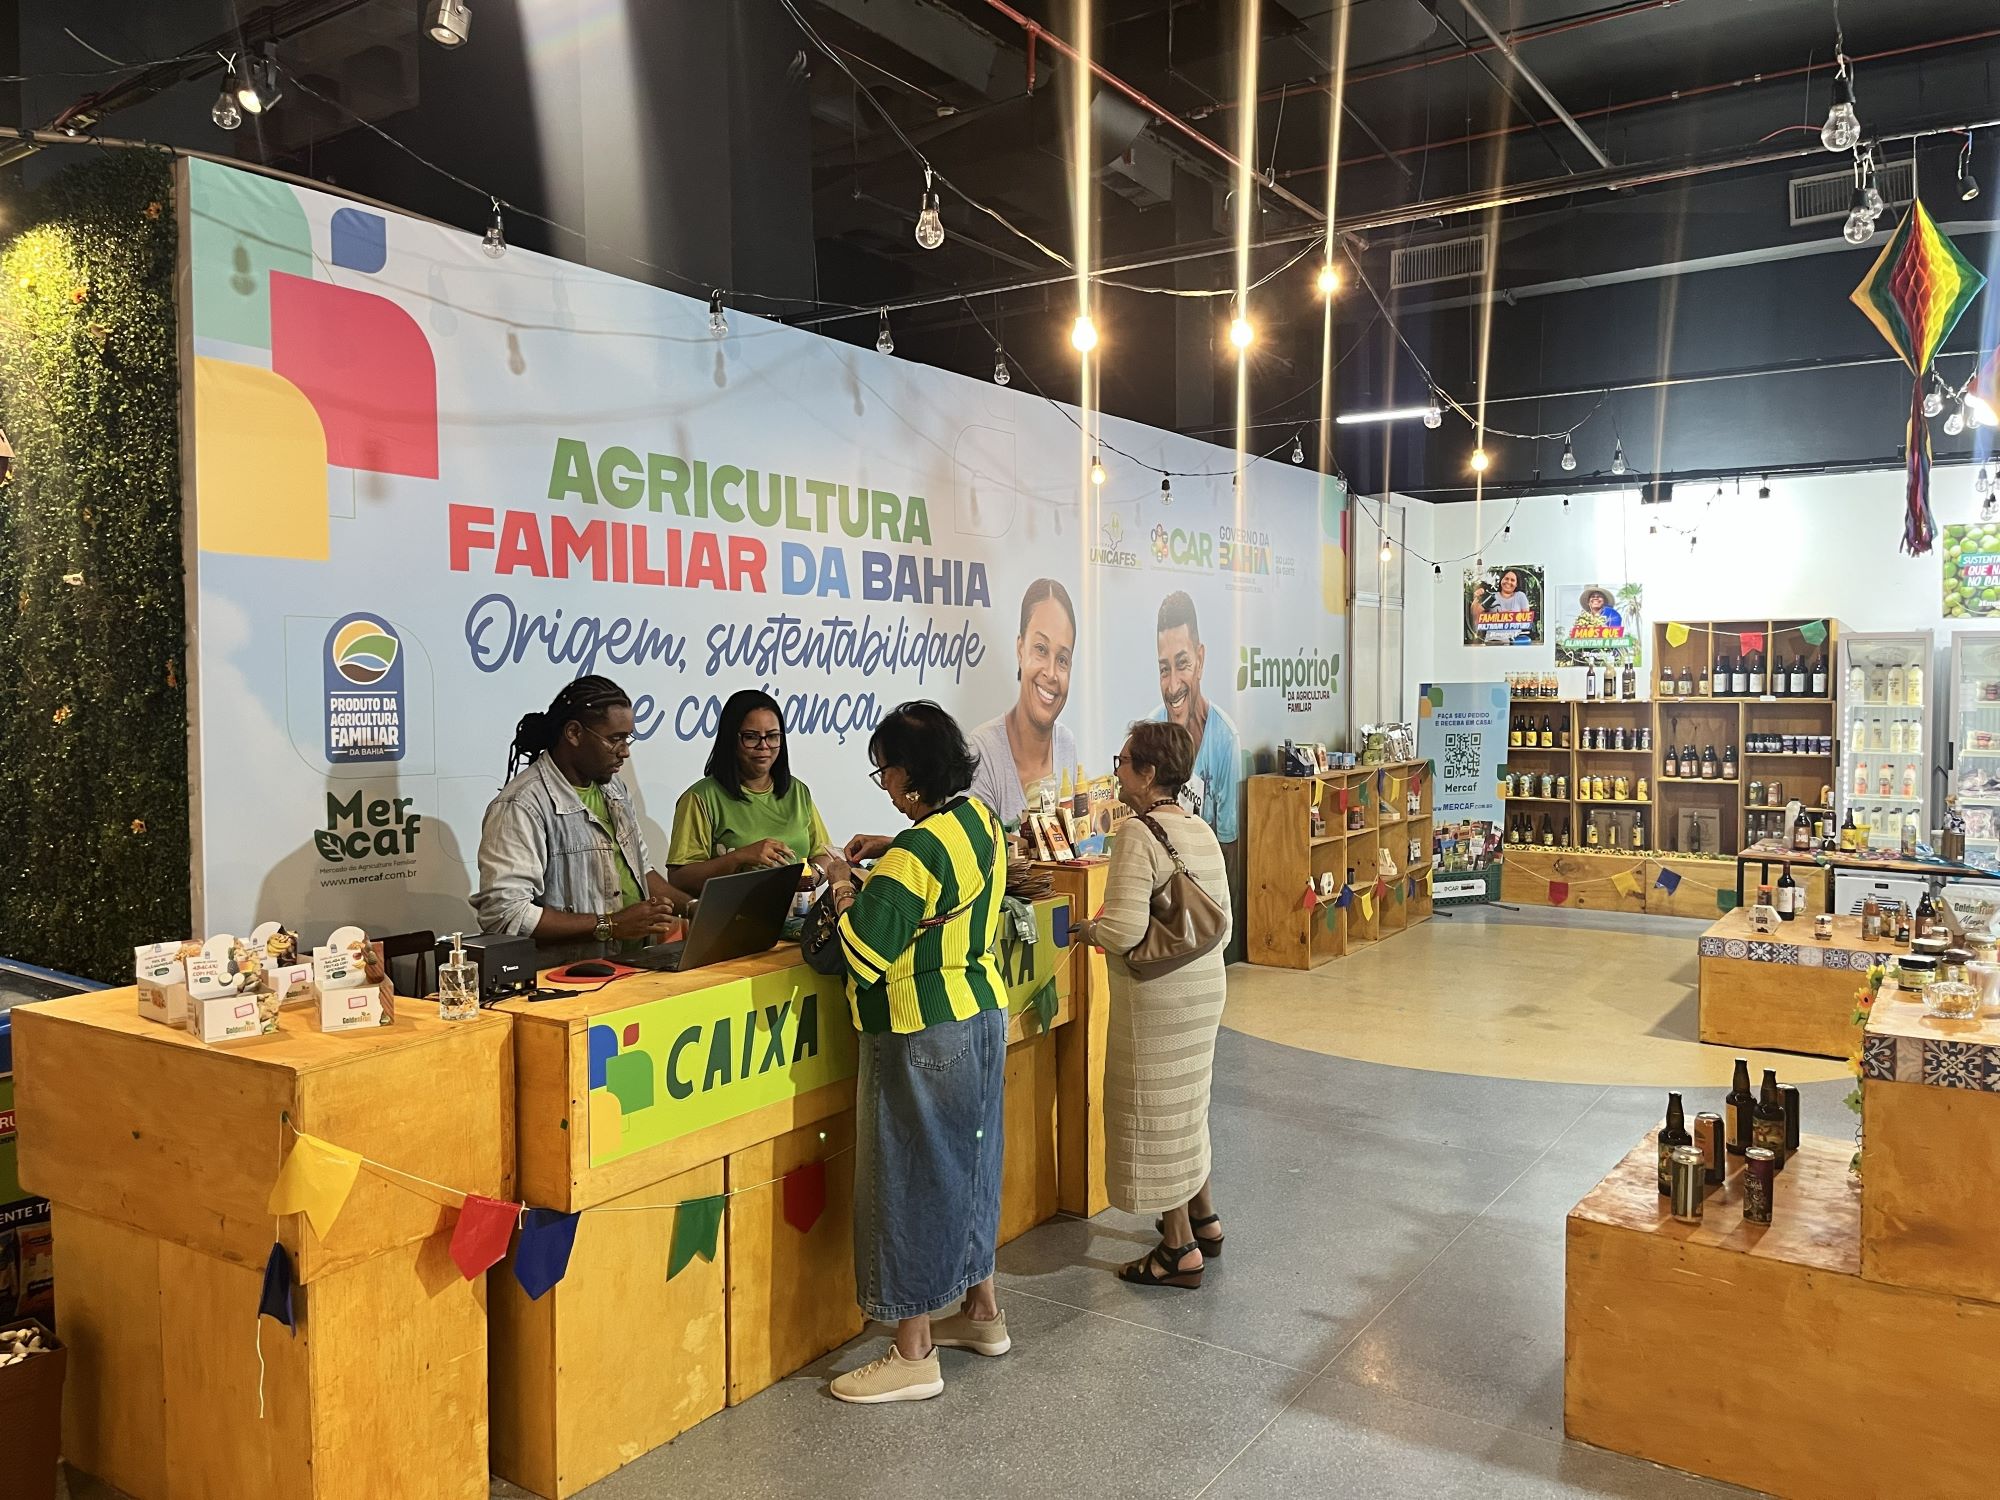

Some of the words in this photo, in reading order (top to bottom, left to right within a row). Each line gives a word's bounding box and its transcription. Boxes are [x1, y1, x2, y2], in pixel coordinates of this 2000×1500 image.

[548, 437, 932, 546] AGRICULTURA
[1219, 526, 1258, 545] GOVERNO
[1259, 532, 1270, 547] DA
[449, 503, 767, 593] FAMILIAR
[781, 541, 850, 599] DA
[862, 550, 991, 608] BAHIA
[1089, 547, 1137, 567] UNICAFES
[1169, 528, 1213, 568] CAR
[1967, 565, 1988, 576] QUE
[1967, 576, 1982, 587] NO
[1515, 612, 1533, 622] QUE
[465, 593, 686, 680] Origem,
[706, 612, 986, 685] sustentabilidade
[1601, 627, 1620, 638] QUE
[1250, 647, 1330, 698] Empório
[330, 697, 381, 712] PRODUTO
[383, 697, 398, 711] DA
[1287, 691, 1295, 701] DA
[1296, 690, 1330, 700] AGRICULTURA
[633, 694, 665, 741] e
[675, 683, 882, 746] coança
[1287, 702, 1312, 713] FAMILIAR
[330, 712, 399, 727] AGRICULTURA
[331, 726, 399, 747] FAMILIAR
[349, 748, 360, 756] DA
[361, 747, 385, 756] BAHIA
[1444, 782, 1478, 793] Mercaf
[327, 789, 414, 831] Mer
[346, 814, 422, 859] caf
[319, 865, 348, 875] Mercado
[358, 861, 393, 871] Agricultura
[393, 858, 417, 867] Familiar
[320, 869, 417, 888] www.mercaf.com.br
[666, 993, 818, 1100] CAIXA
